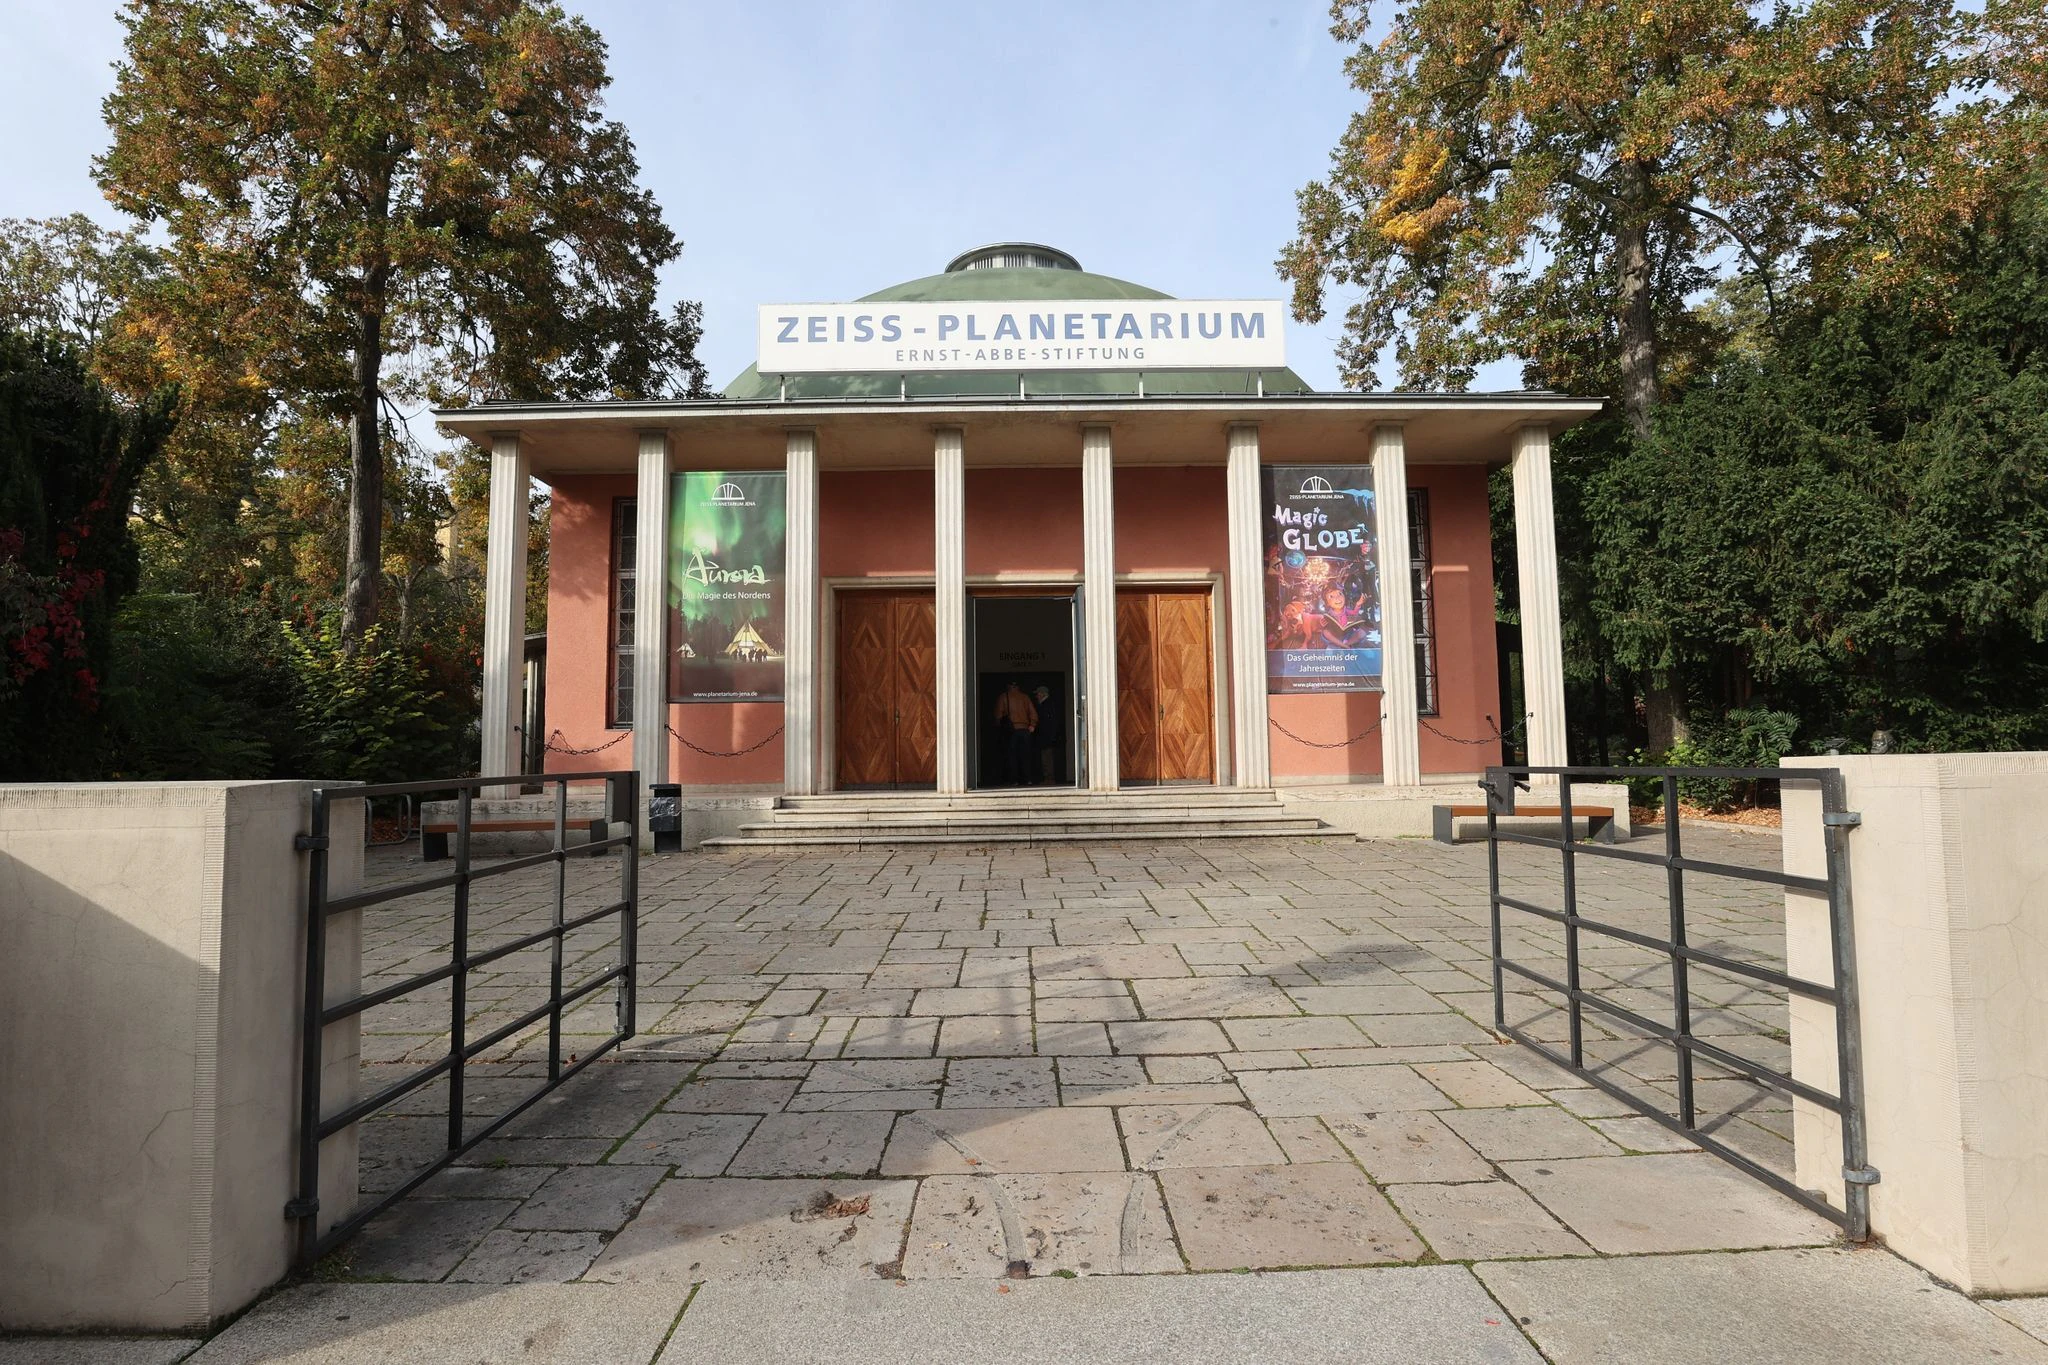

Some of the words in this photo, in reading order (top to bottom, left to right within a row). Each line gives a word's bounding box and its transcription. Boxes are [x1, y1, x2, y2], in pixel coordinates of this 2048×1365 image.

[777, 313, 1264, 342] ZEISS-PLANETARIUM
[896, 347, 1144, 361] ERNST-ABBE-STIFTUNG
[1272, 504, 1328, 529] Magic
[1282, 527, 1364, 551] GLOBE
[683, 549, 774, 586] Aurora
[697, 592, 721, 602] Magie
[722, 592, 737, 600] des
[738, 592, 771, 600] Nordens
[1287, 653, 1302, 662] Das
[1302, 653, 1343, 662] Geheimnis
[1344, 653, 1358, 661] der
[1299, 664, 1346, 672] Jahreszeiten
